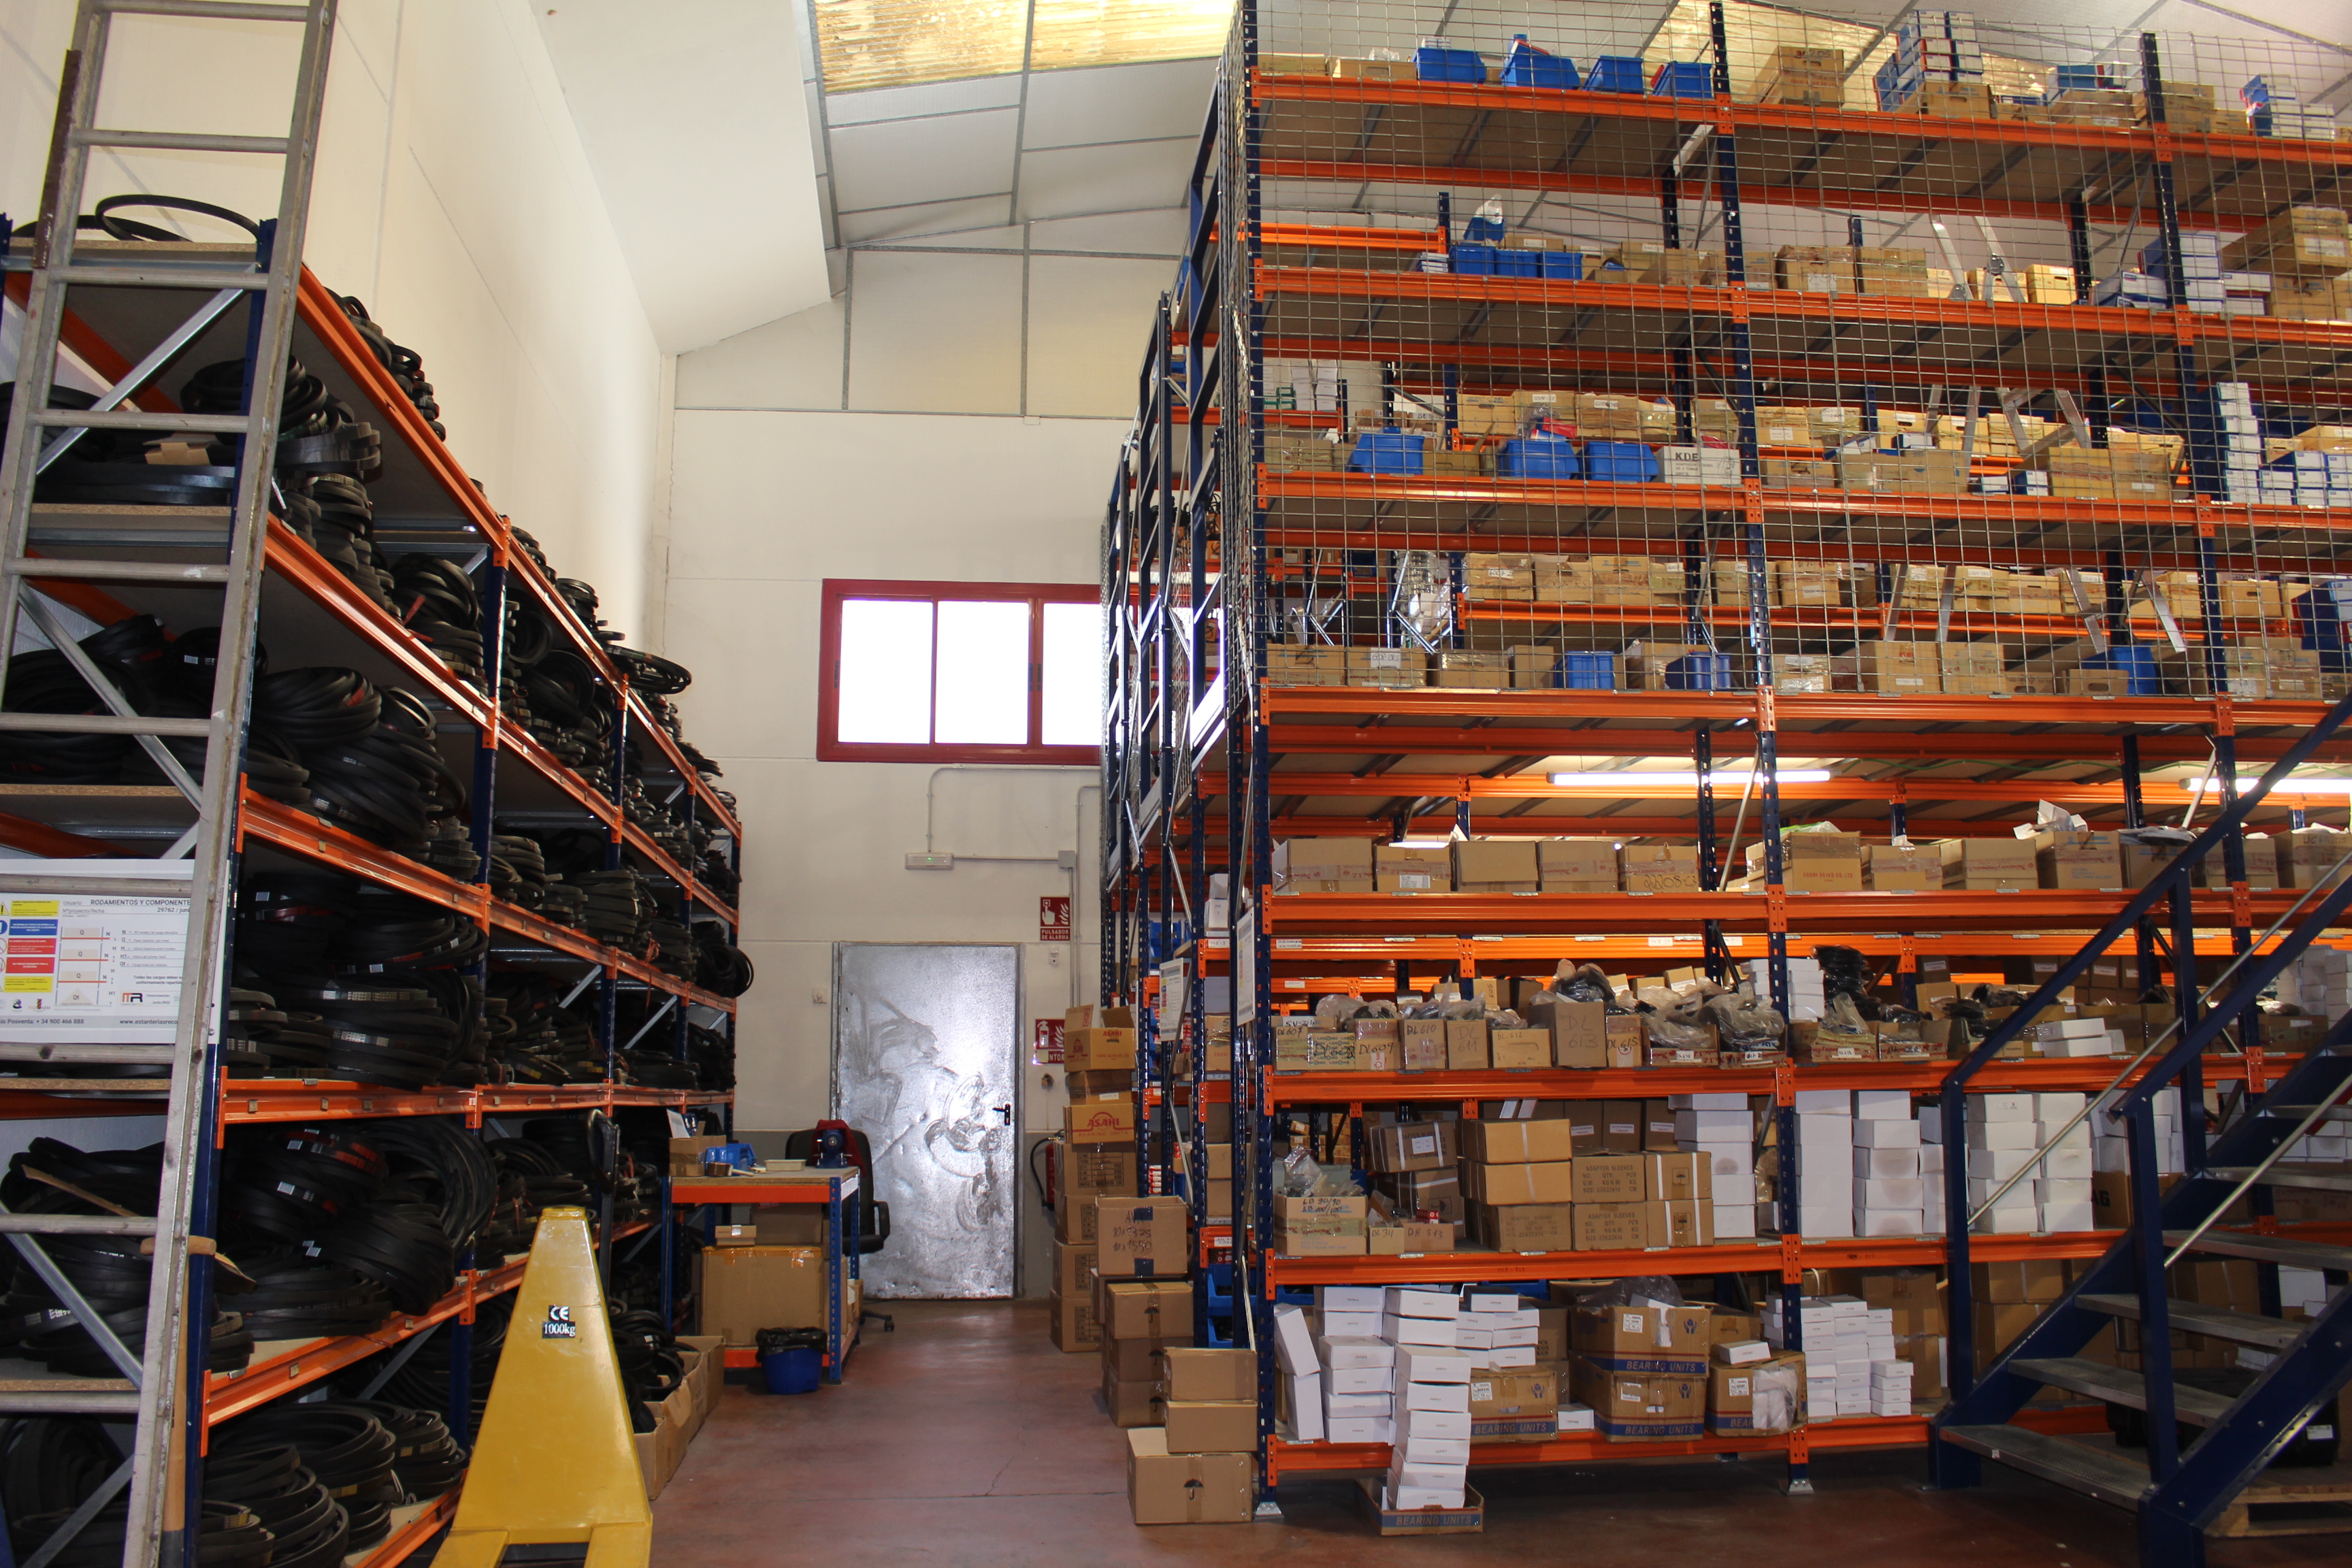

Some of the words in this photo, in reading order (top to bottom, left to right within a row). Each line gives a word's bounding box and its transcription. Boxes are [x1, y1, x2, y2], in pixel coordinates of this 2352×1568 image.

[1087, 1118, 1120, 1127] ASAHI
[544, 1323, 576, 1337] 1000kg
[1627, 1360, 1666, 1371] BEARING
[1669, 1362, 1696, 1372] UNITS
[1474, 1424, 1516, 1434] BEARING
[1520, 1422, 1547, 1432] UNITS
[1625, 1426, 1665, 1435] BEARING
[1669, 1425, 1695, 1434] UNITS
[1396, 1516, 1439, 1525] BEARING
[1443, 1515, 1471, 1525] UNITS
